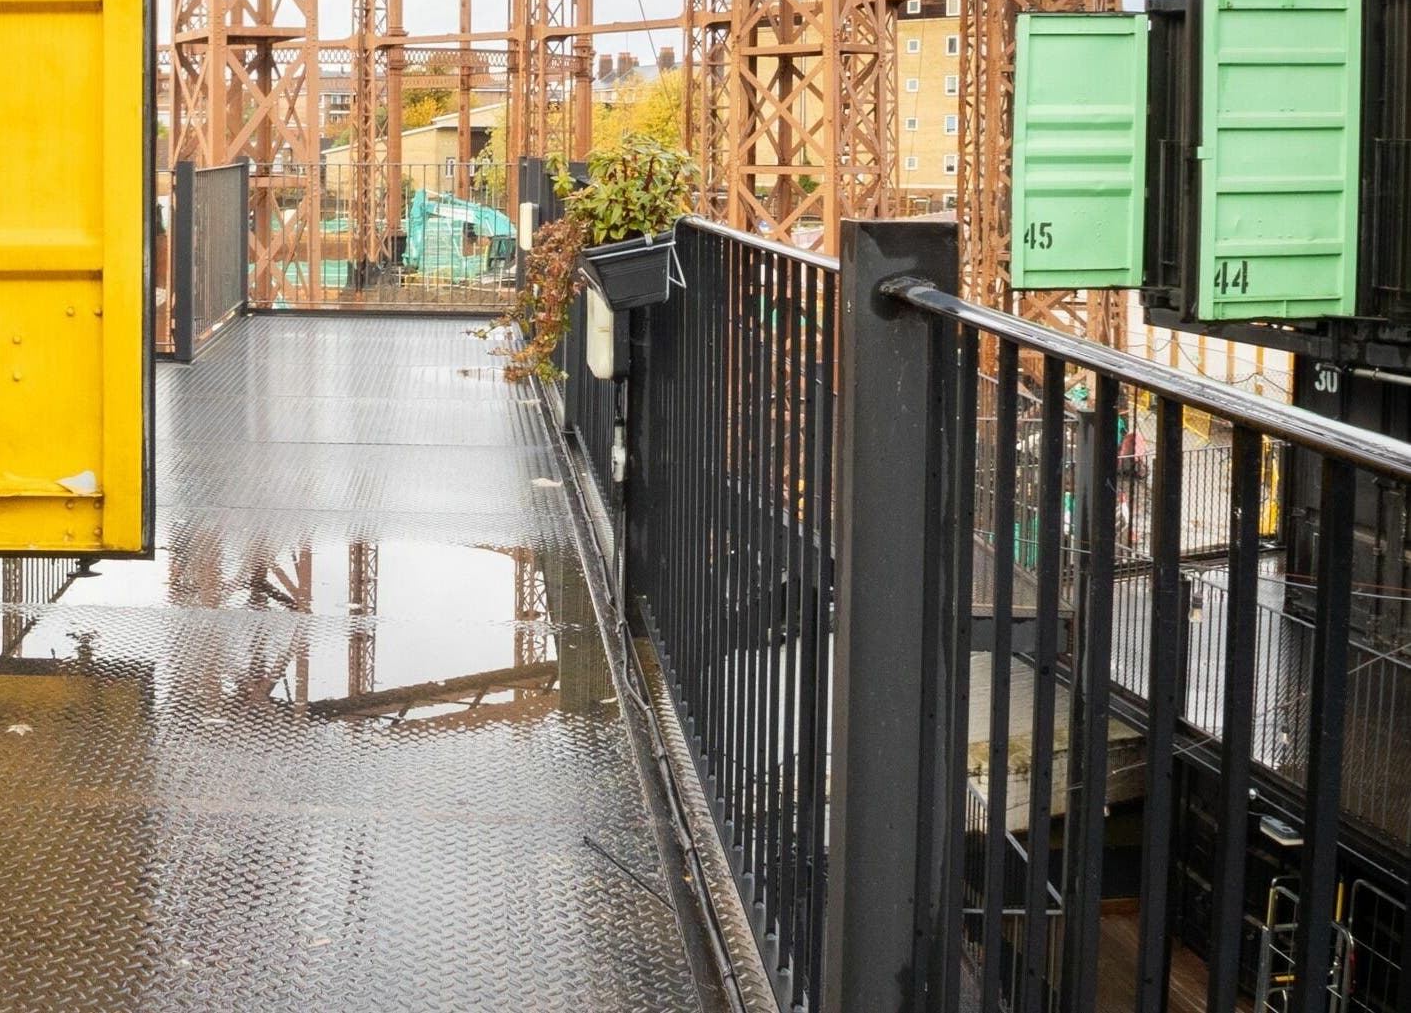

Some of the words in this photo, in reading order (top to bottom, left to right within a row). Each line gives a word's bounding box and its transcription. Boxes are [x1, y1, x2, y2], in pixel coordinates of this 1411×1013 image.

[1024, 222, 1052, 249] 45
[1214, 260, 1248, 294] 44
[1315, 363, 1338, 393] 30
